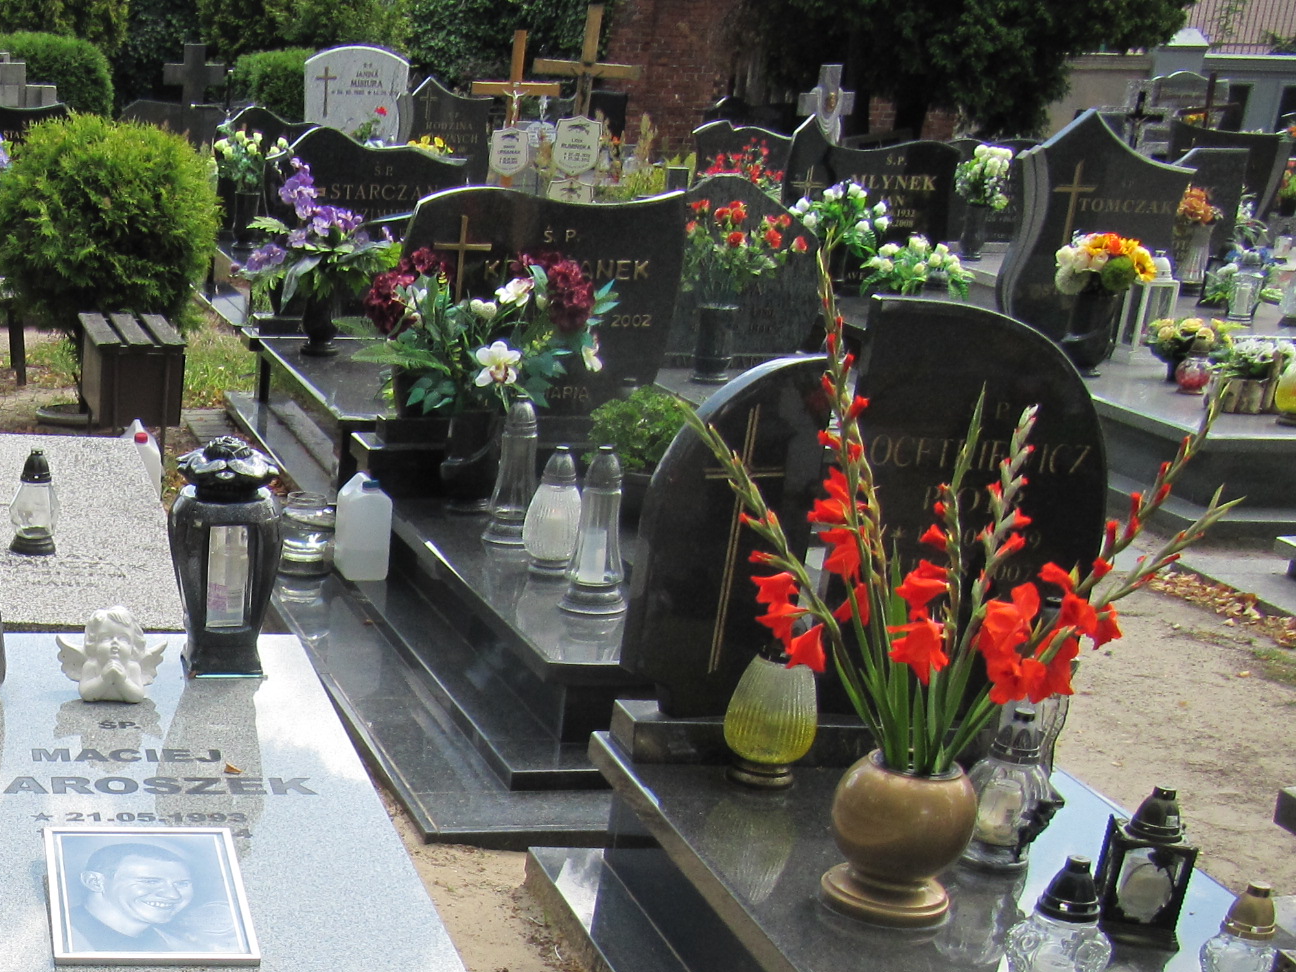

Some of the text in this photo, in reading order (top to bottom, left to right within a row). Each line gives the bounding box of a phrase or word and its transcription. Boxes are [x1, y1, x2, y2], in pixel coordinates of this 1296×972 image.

[1079, 197, 1174, 213] TOMCZAK
[611, 314, 652, 327] 2002
[30, 748, 222, 763] MACIEJ
[65, 812, 248, 823] 21.05.1993
